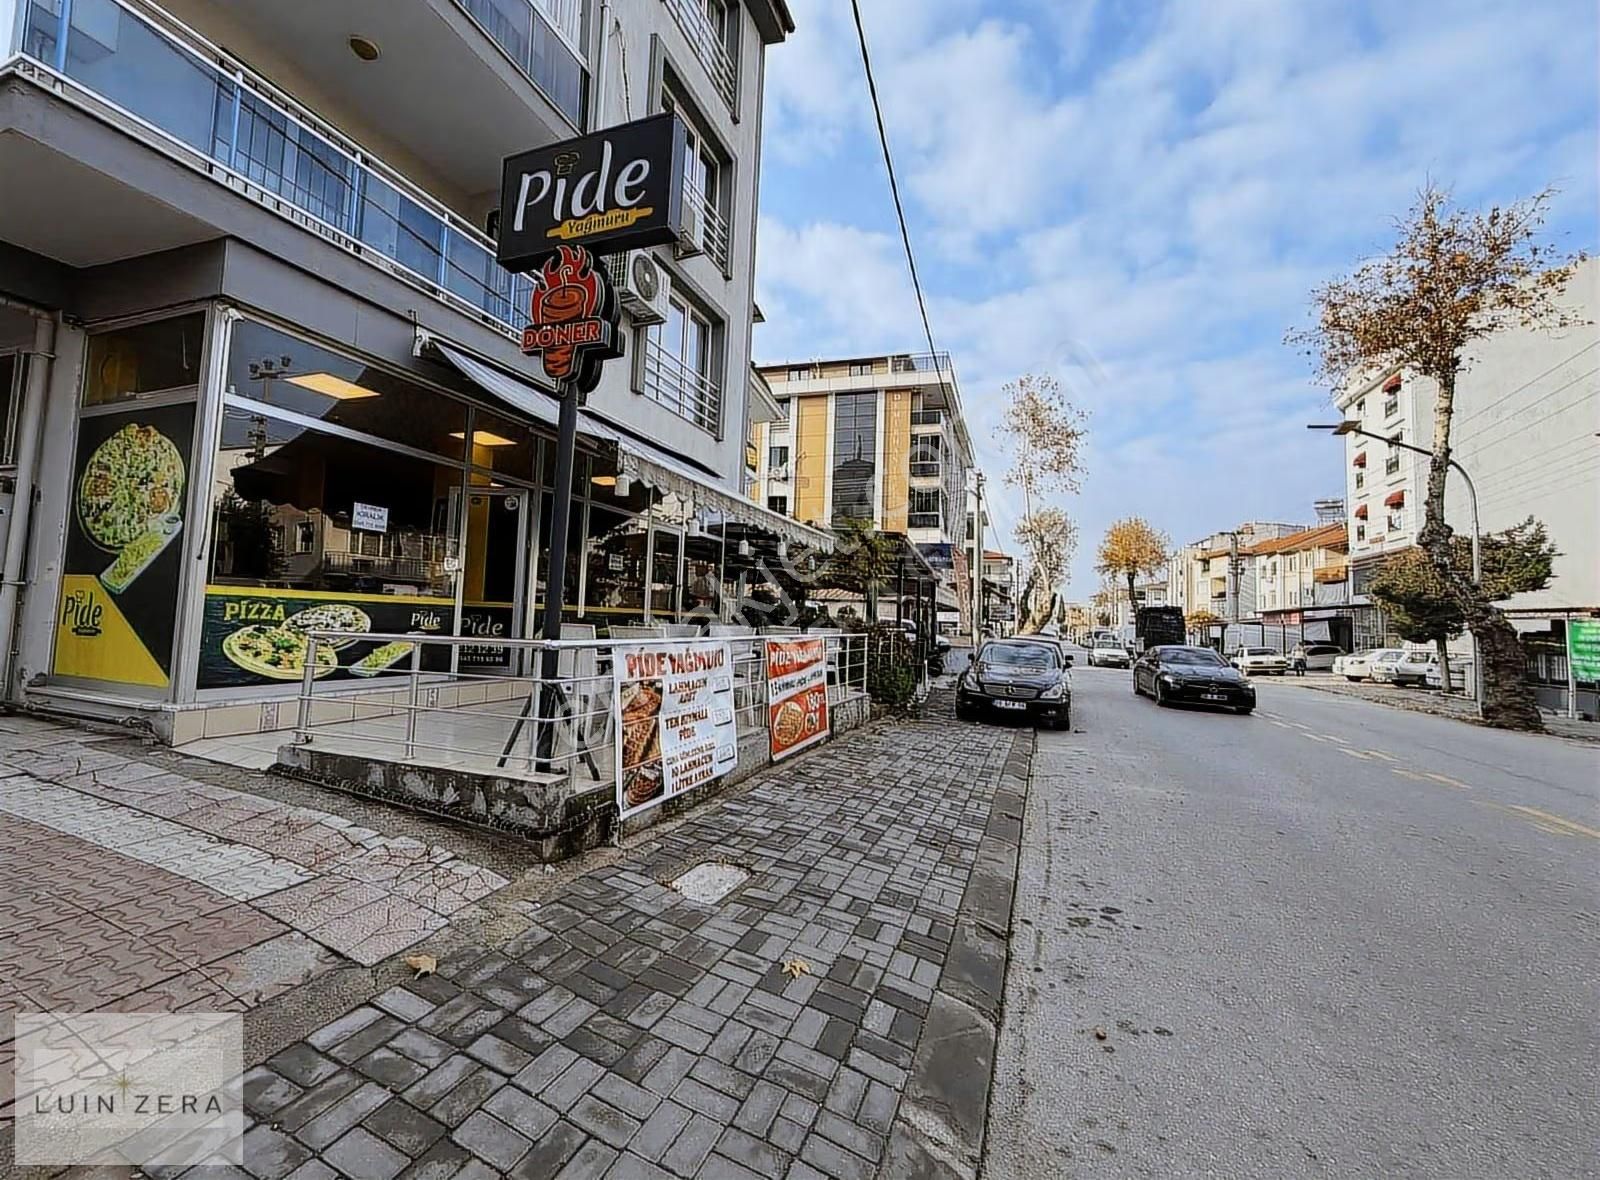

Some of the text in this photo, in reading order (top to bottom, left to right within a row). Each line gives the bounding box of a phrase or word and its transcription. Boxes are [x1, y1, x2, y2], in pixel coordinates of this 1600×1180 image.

[513, 140, 650, 232] Pide
[567, 211, 631, 236] Yağmuru
[523, 321, 602, 350] DÖNER
[62, 591, 103, 626] Pide
[411, 611, 441, 627] Pide
